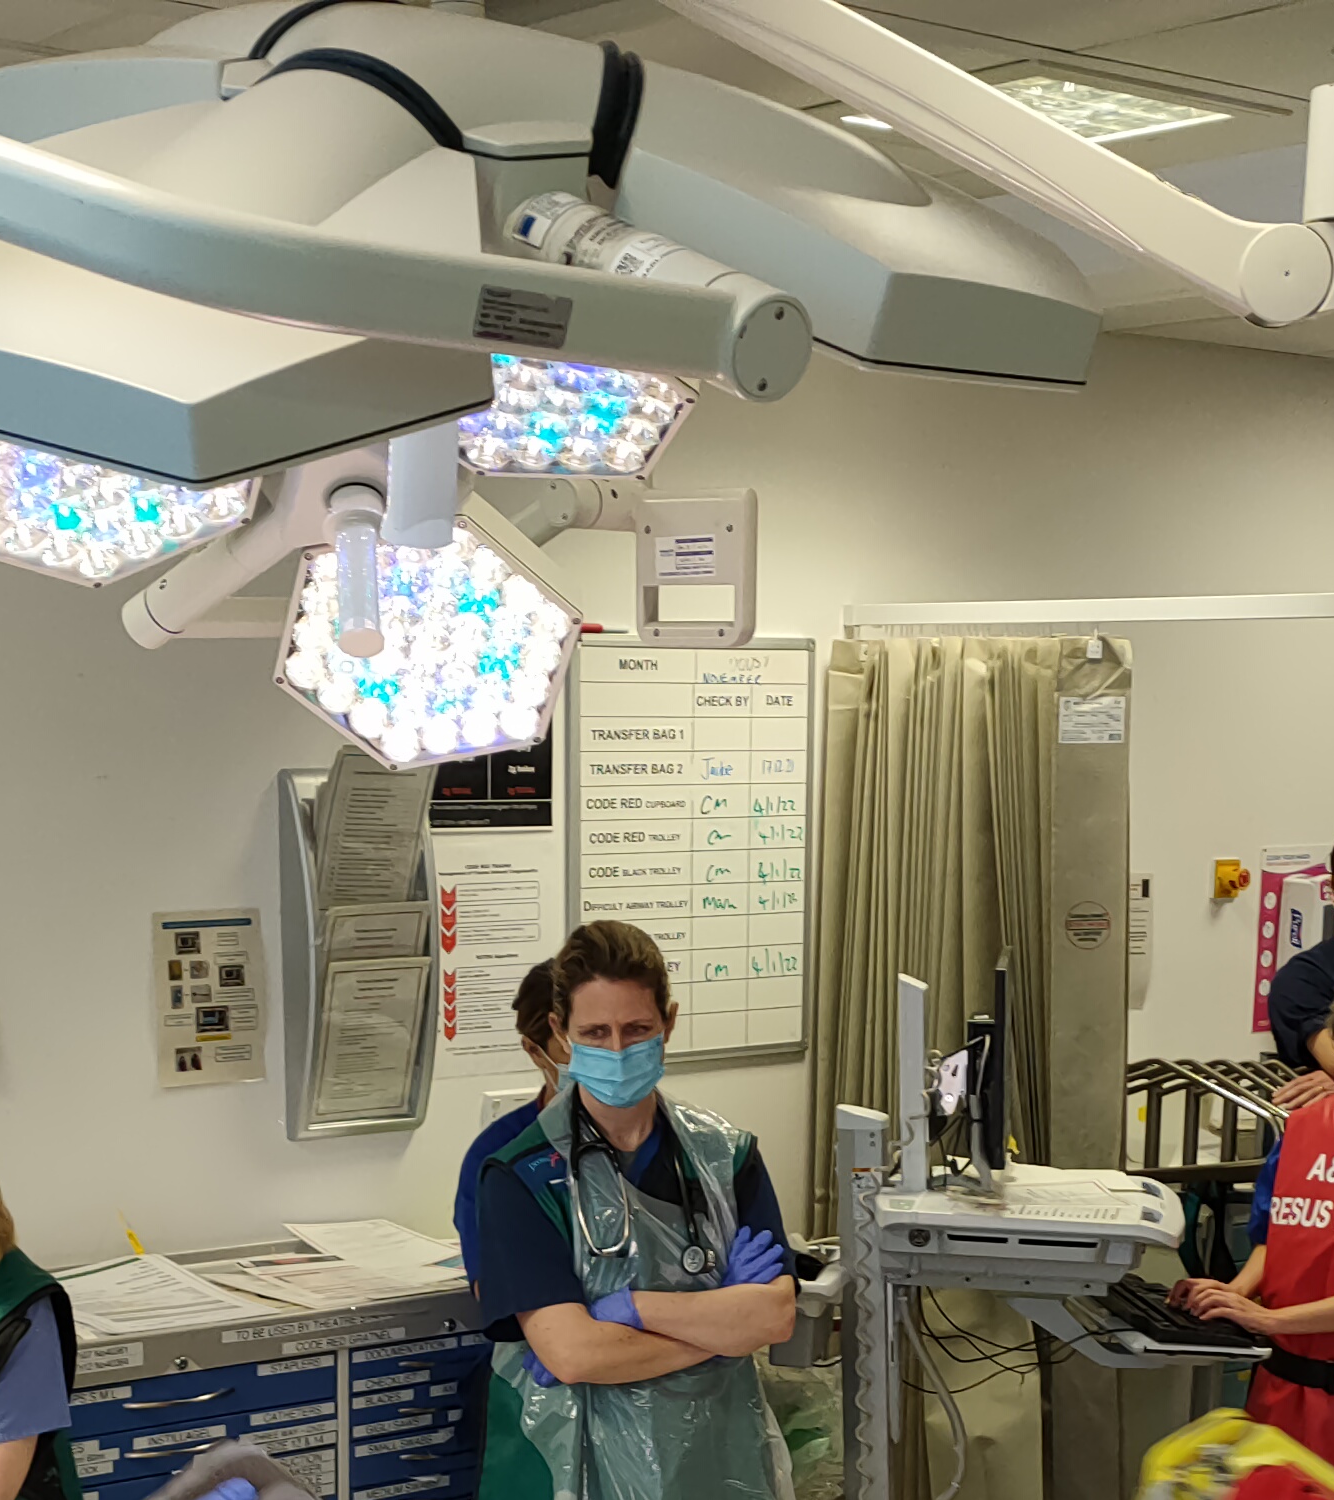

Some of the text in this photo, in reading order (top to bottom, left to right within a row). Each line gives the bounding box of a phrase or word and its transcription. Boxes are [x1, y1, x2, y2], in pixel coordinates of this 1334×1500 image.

[618, 658, 658, 671] MONTH
[702, 673, 763, 685] NOVEMBER
[696, 695, 749, 708] CHECK BY
[765, 695, 794, 707] DATE
[591, 729, 650, 741] TRANSFER
[652, 728, 677, 740] BAG
[590, 763, 684, 775] TRANSFER BAG 2
[586, 798, 687, 810] CODE RED CUPBOARD
[589, 832, 681, 844] CODE RED TROLLEY
[588, 866, 682, 878] CODE BLACK TROLLEY
[625, 900, 654, 910] AIRWAY
[656, 899, 688, 909] TROLLEY
[654, 932, 686, 941] TROLLEY
[1270, 1196, 1334, 1229] RESUS
[236, 1330, 250, 1341] TO
[252, 1328, 265, 1339] BE
[267, 1324, 295, 1337] USED
[298, 1322, 310, 1333] BY
[313, 1316, 359, 1329] THEATRE
[295, 1339, 323, 1351] CODE
[325, 1337, 347, 1348] RED
[365, 1340, 446, 1360] DOCUMENTATION
[270, 1357, 322, 1373] STAPLERS
[365, 1373, 417, 1389] CHECKLIST
[365, 1392, 402, 1406] BLADES
[263, 1405, 322, 1423] CATHETERS
[147, 1429, 211, 1446] INSTILLAGEL
[368, 1436, 433, 1453] SMALL SWABS
[366, 1485, 404, 1499] MEDIUM
